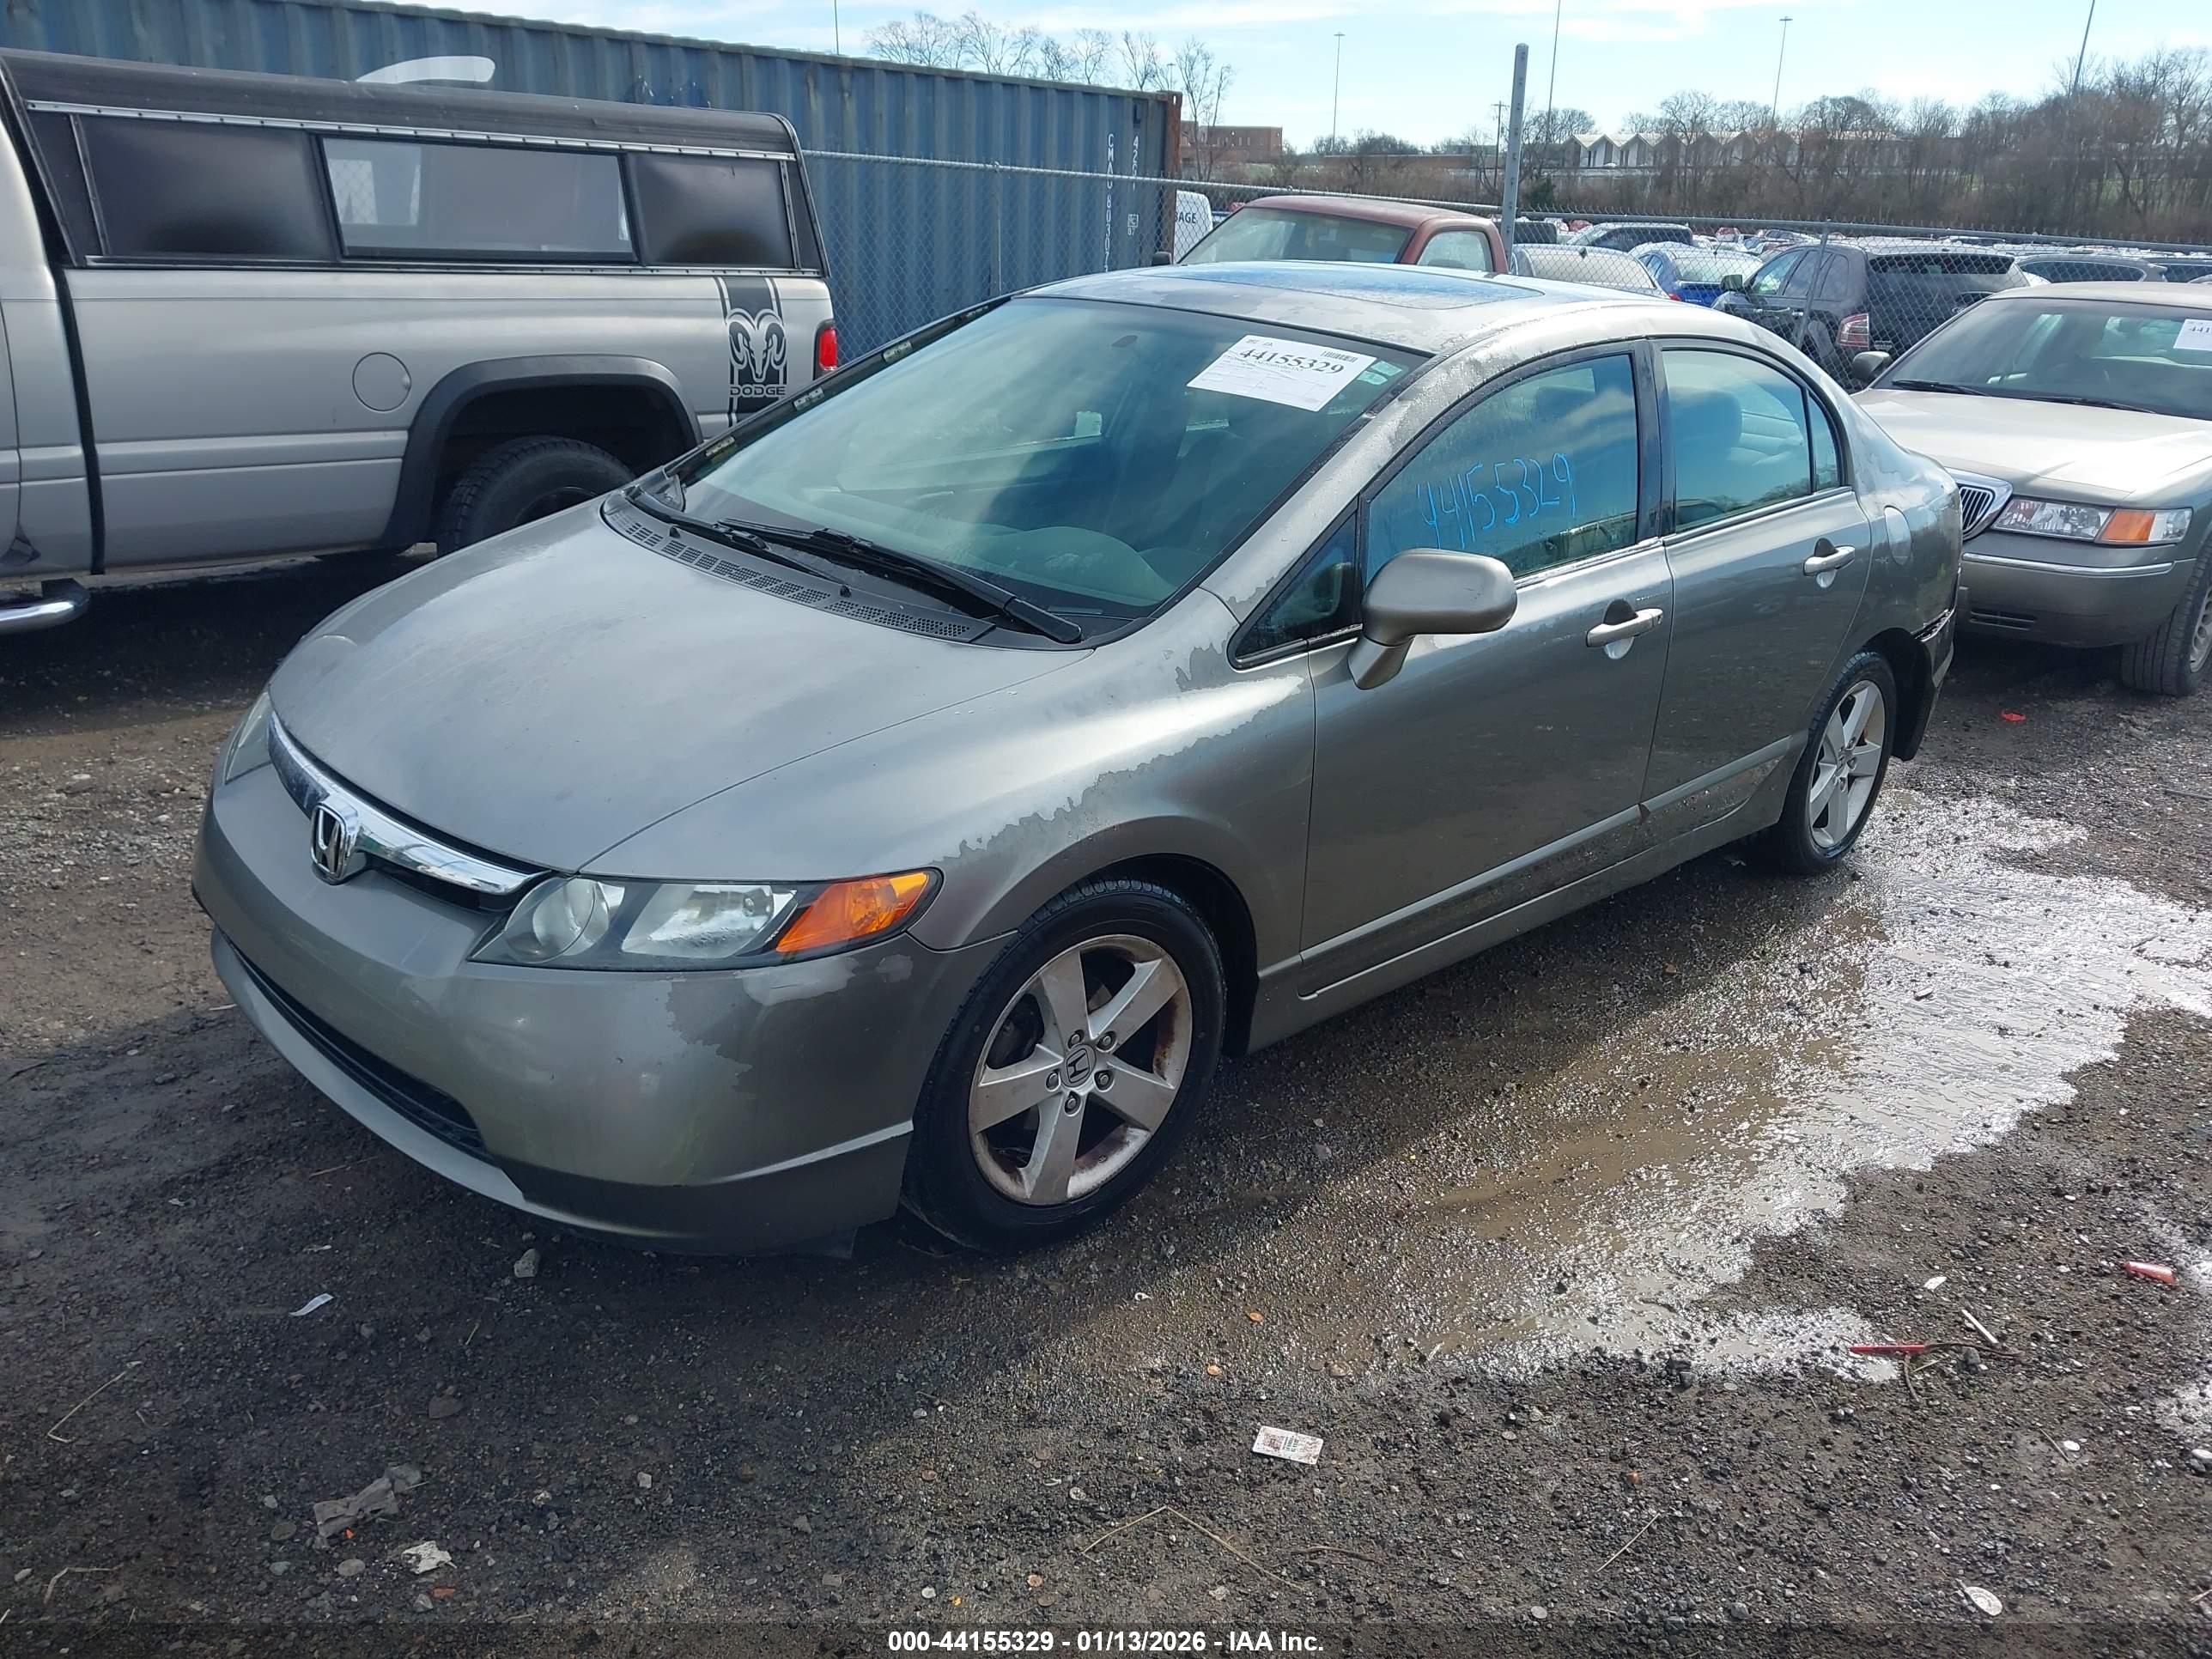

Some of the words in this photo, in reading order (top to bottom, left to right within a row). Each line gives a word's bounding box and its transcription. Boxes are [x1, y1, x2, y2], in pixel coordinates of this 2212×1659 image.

[1239, 349, 1345, 374] 44155329
[730, 386, 786, 396] DODGE
[1417, 453, 1577, 550] 44155329
